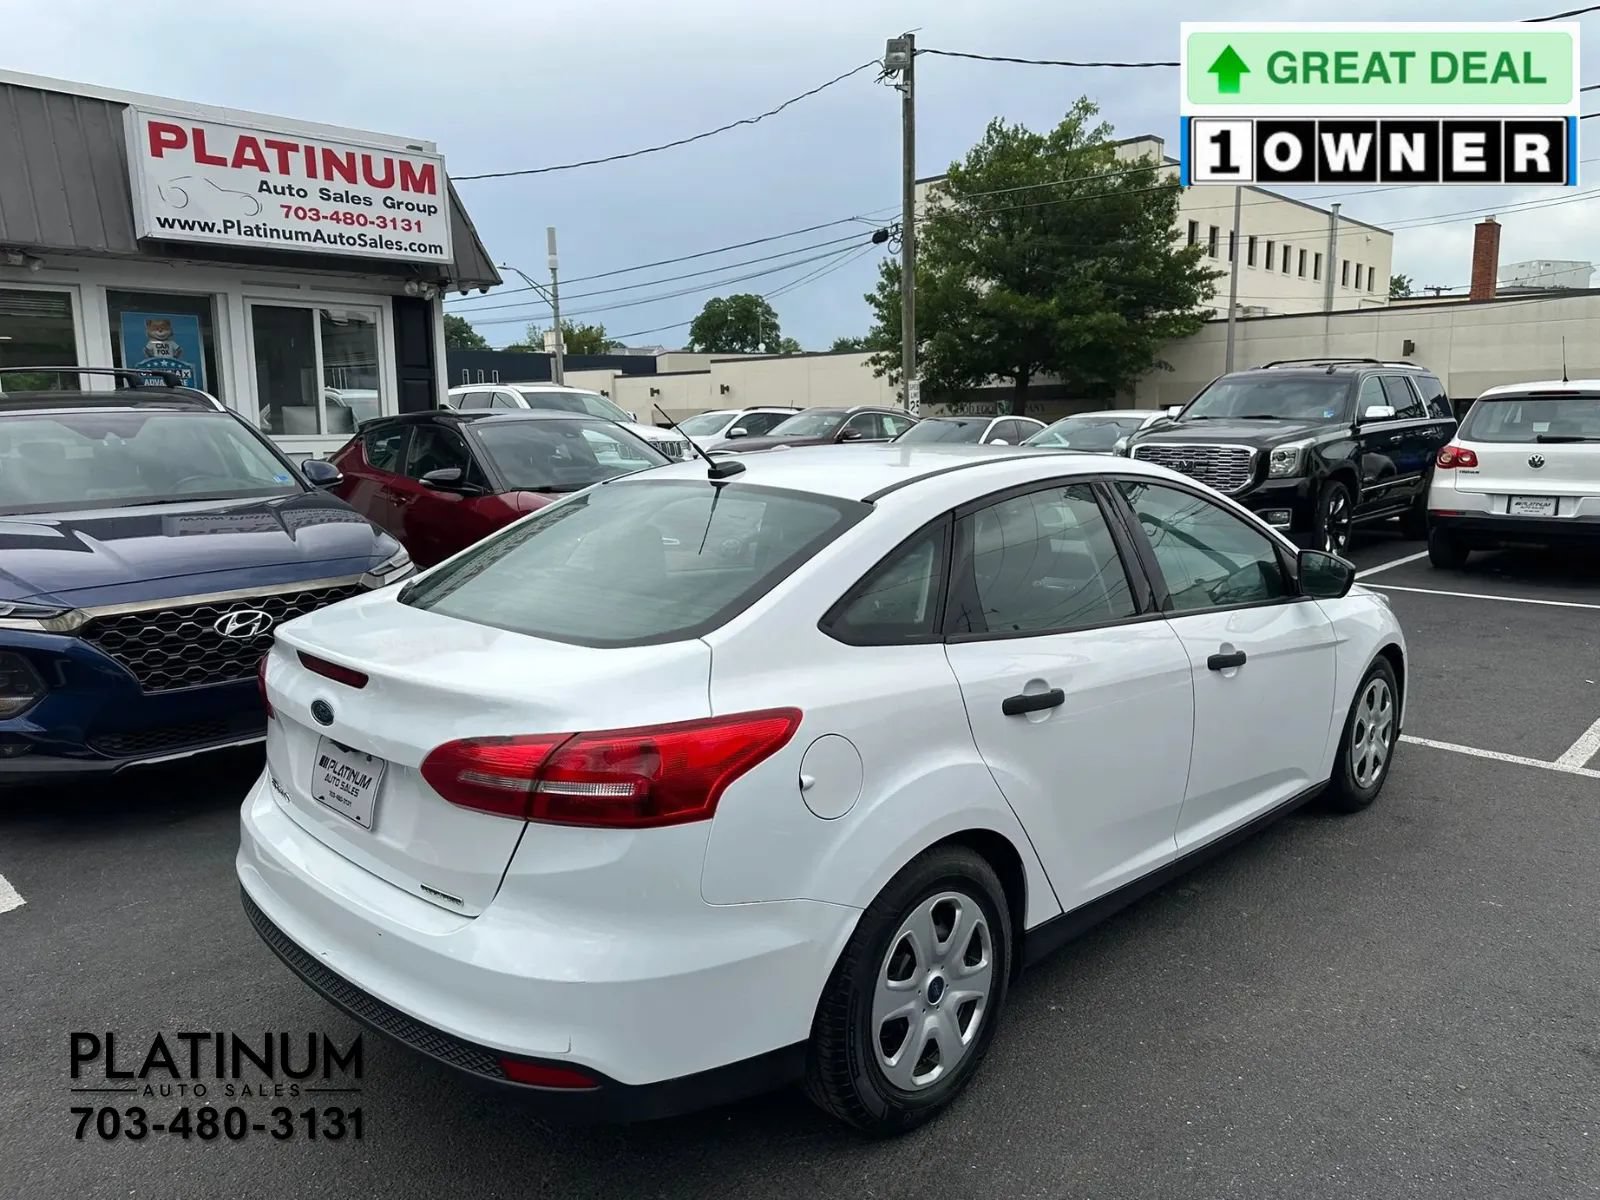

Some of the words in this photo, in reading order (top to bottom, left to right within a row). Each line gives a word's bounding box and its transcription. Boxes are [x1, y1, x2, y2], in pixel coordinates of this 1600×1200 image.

[147, 120, 437, 196] PLATINUM
[257, 180, 309, 199] Auto
[318, 187, 373, 207] Sales
[382, 195, 438, 217] Group
[280, 204, 423, 234] 703-480-3131
[156, 215, 444, 256] www.PlatinumAutoSales.com
[1166, 460, 1209, 474] GMC
[324, 774, 340, 787] AUTO
[340, 782, 360, 797] SALES
[328, 759, 373, 790] PLATINUM
